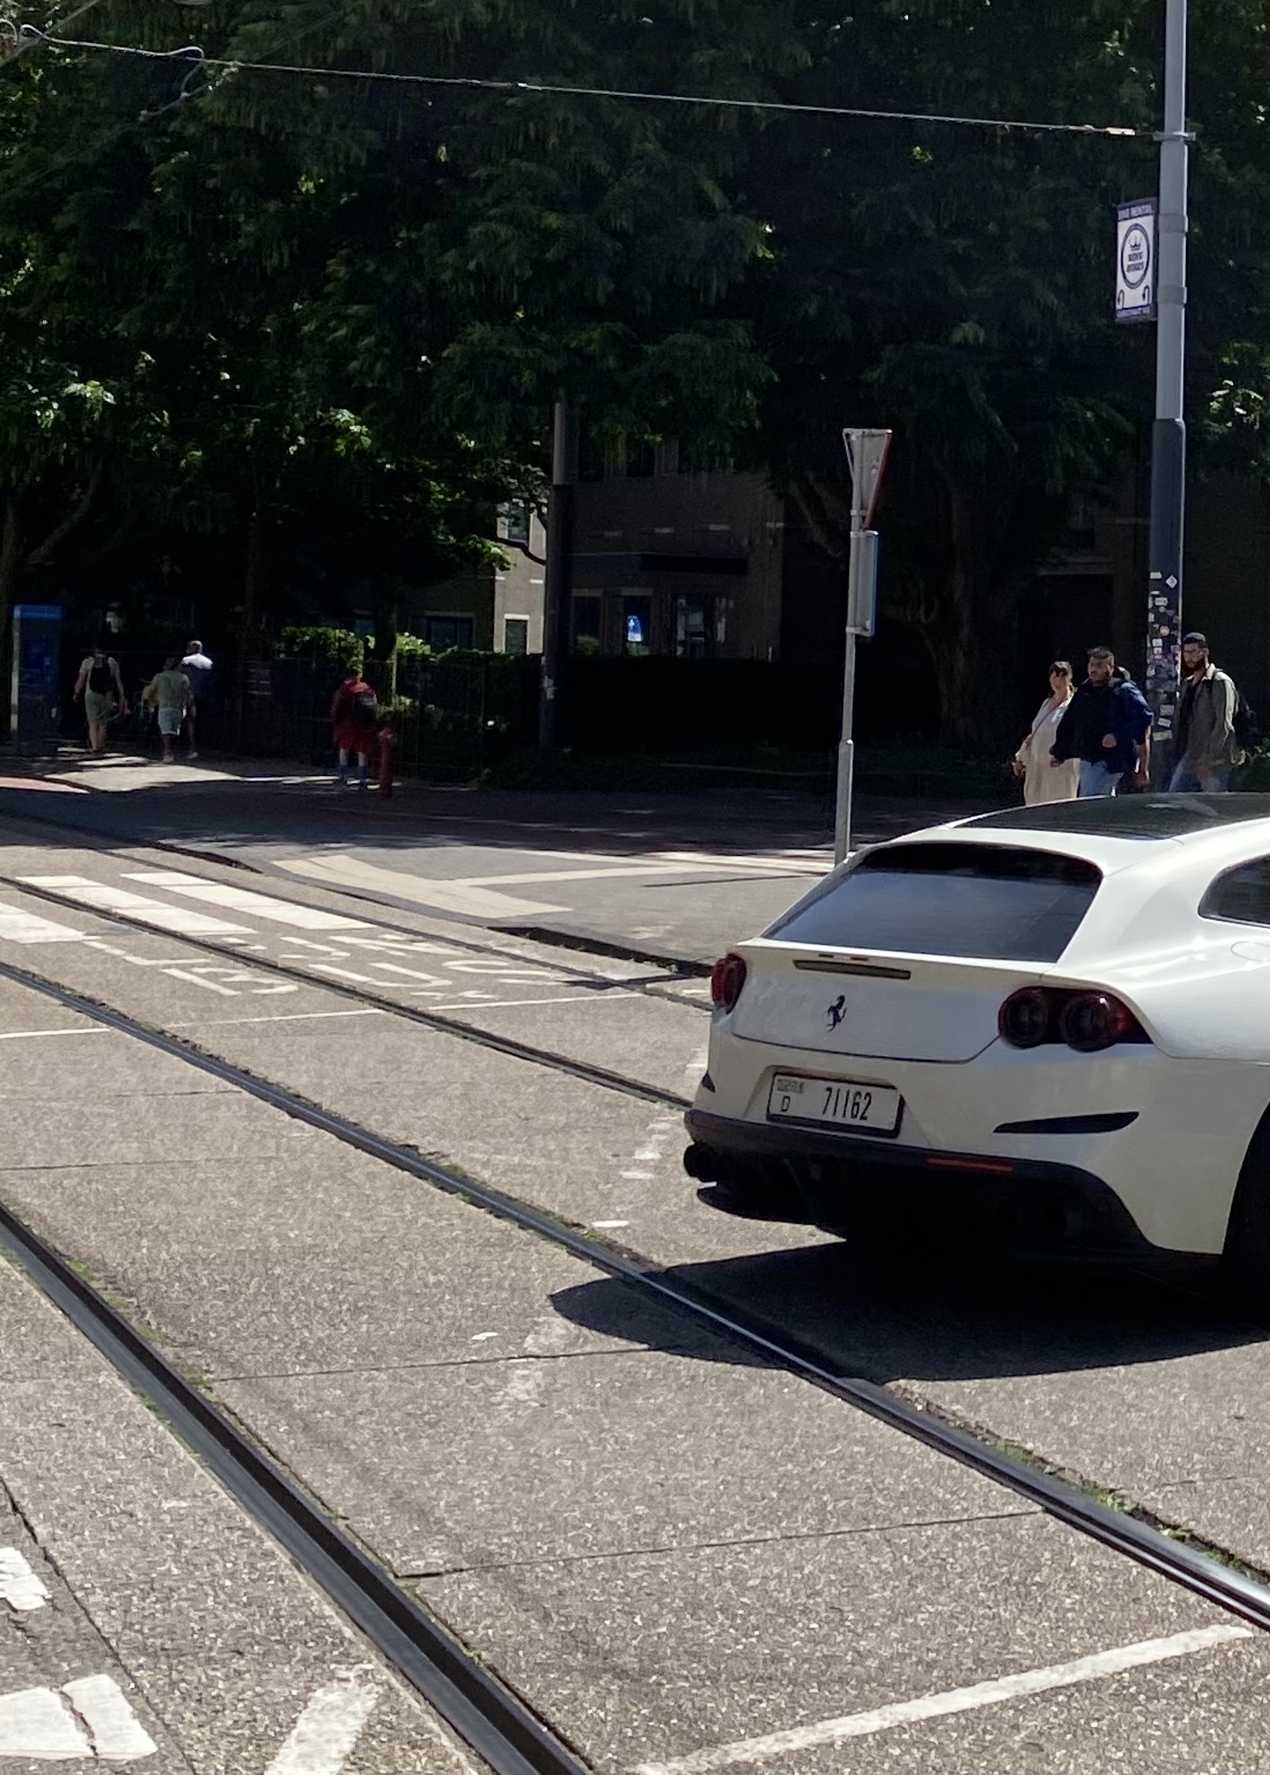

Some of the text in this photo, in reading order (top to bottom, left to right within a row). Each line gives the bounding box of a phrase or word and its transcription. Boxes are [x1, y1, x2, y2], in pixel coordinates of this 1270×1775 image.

[160, 960, 573, 996] BUS
[780, 1087, 872, 1120] D 71162
